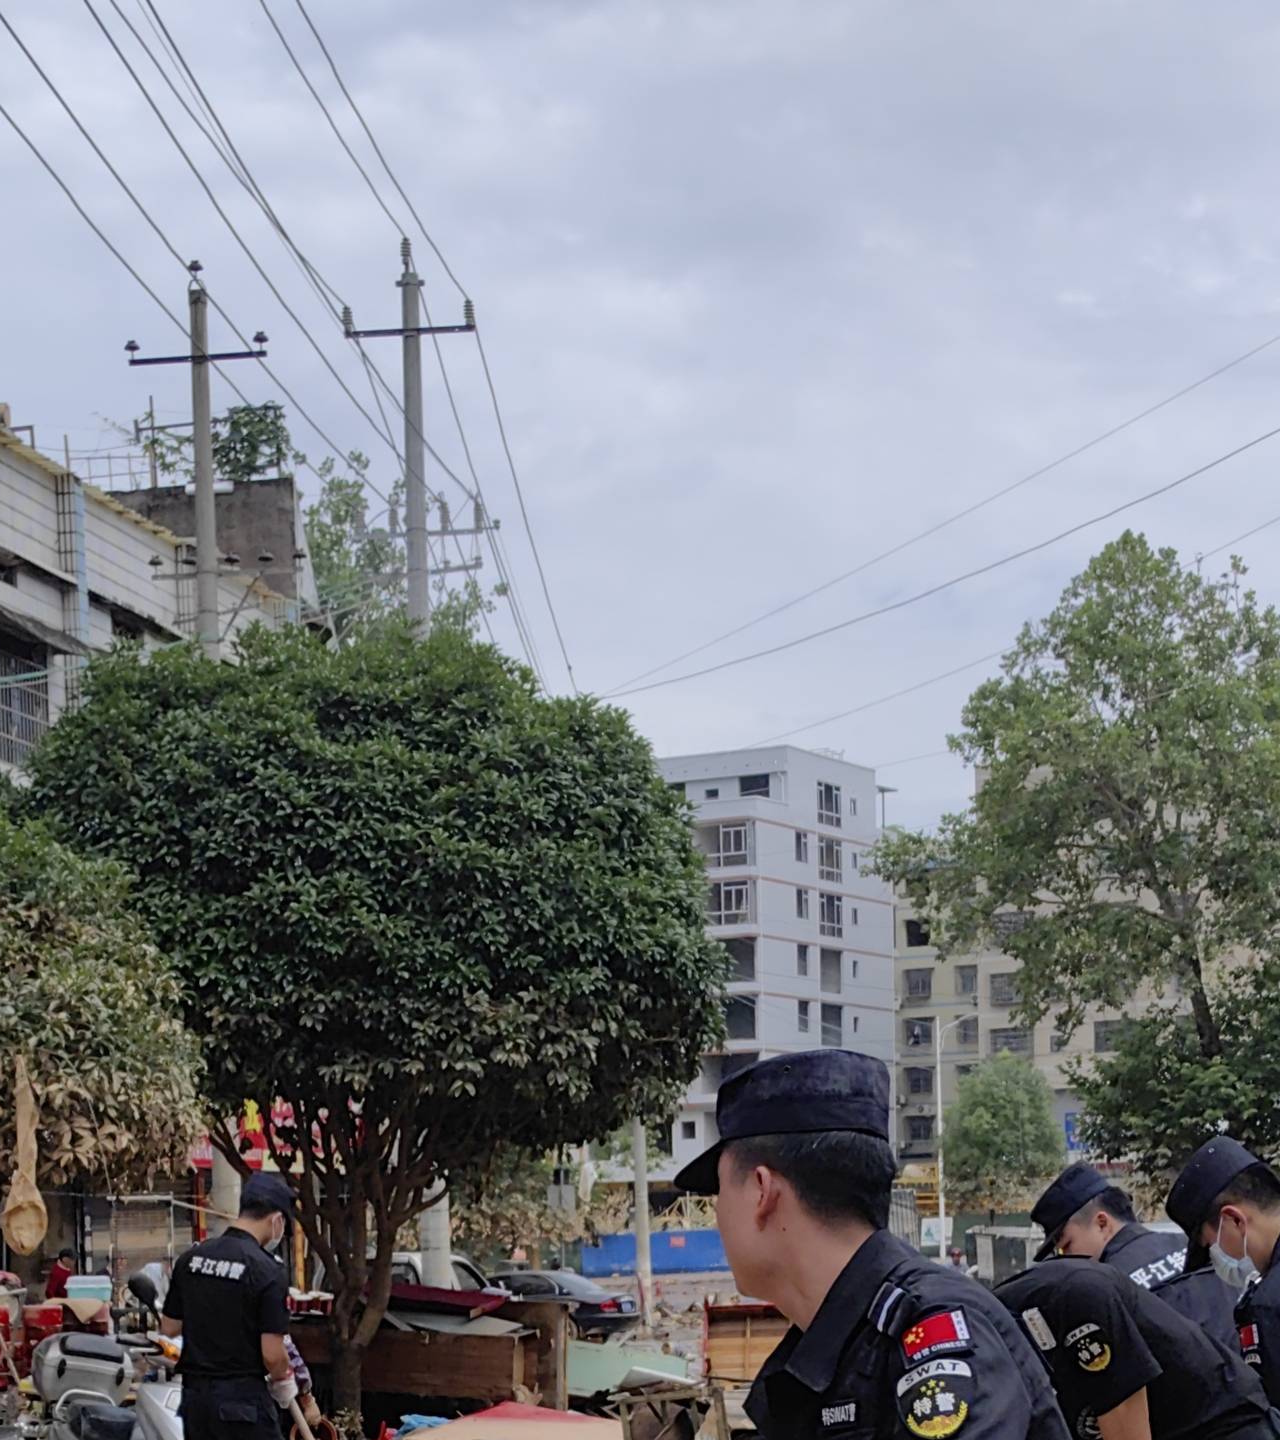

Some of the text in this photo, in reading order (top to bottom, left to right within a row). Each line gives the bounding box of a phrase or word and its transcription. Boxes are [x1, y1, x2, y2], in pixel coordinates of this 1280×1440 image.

[189, 1255, 246, 1281] 平江特警
[904, 1362, 961, 1386] SWAT
[913, 1392, 956, 1417] 特警
